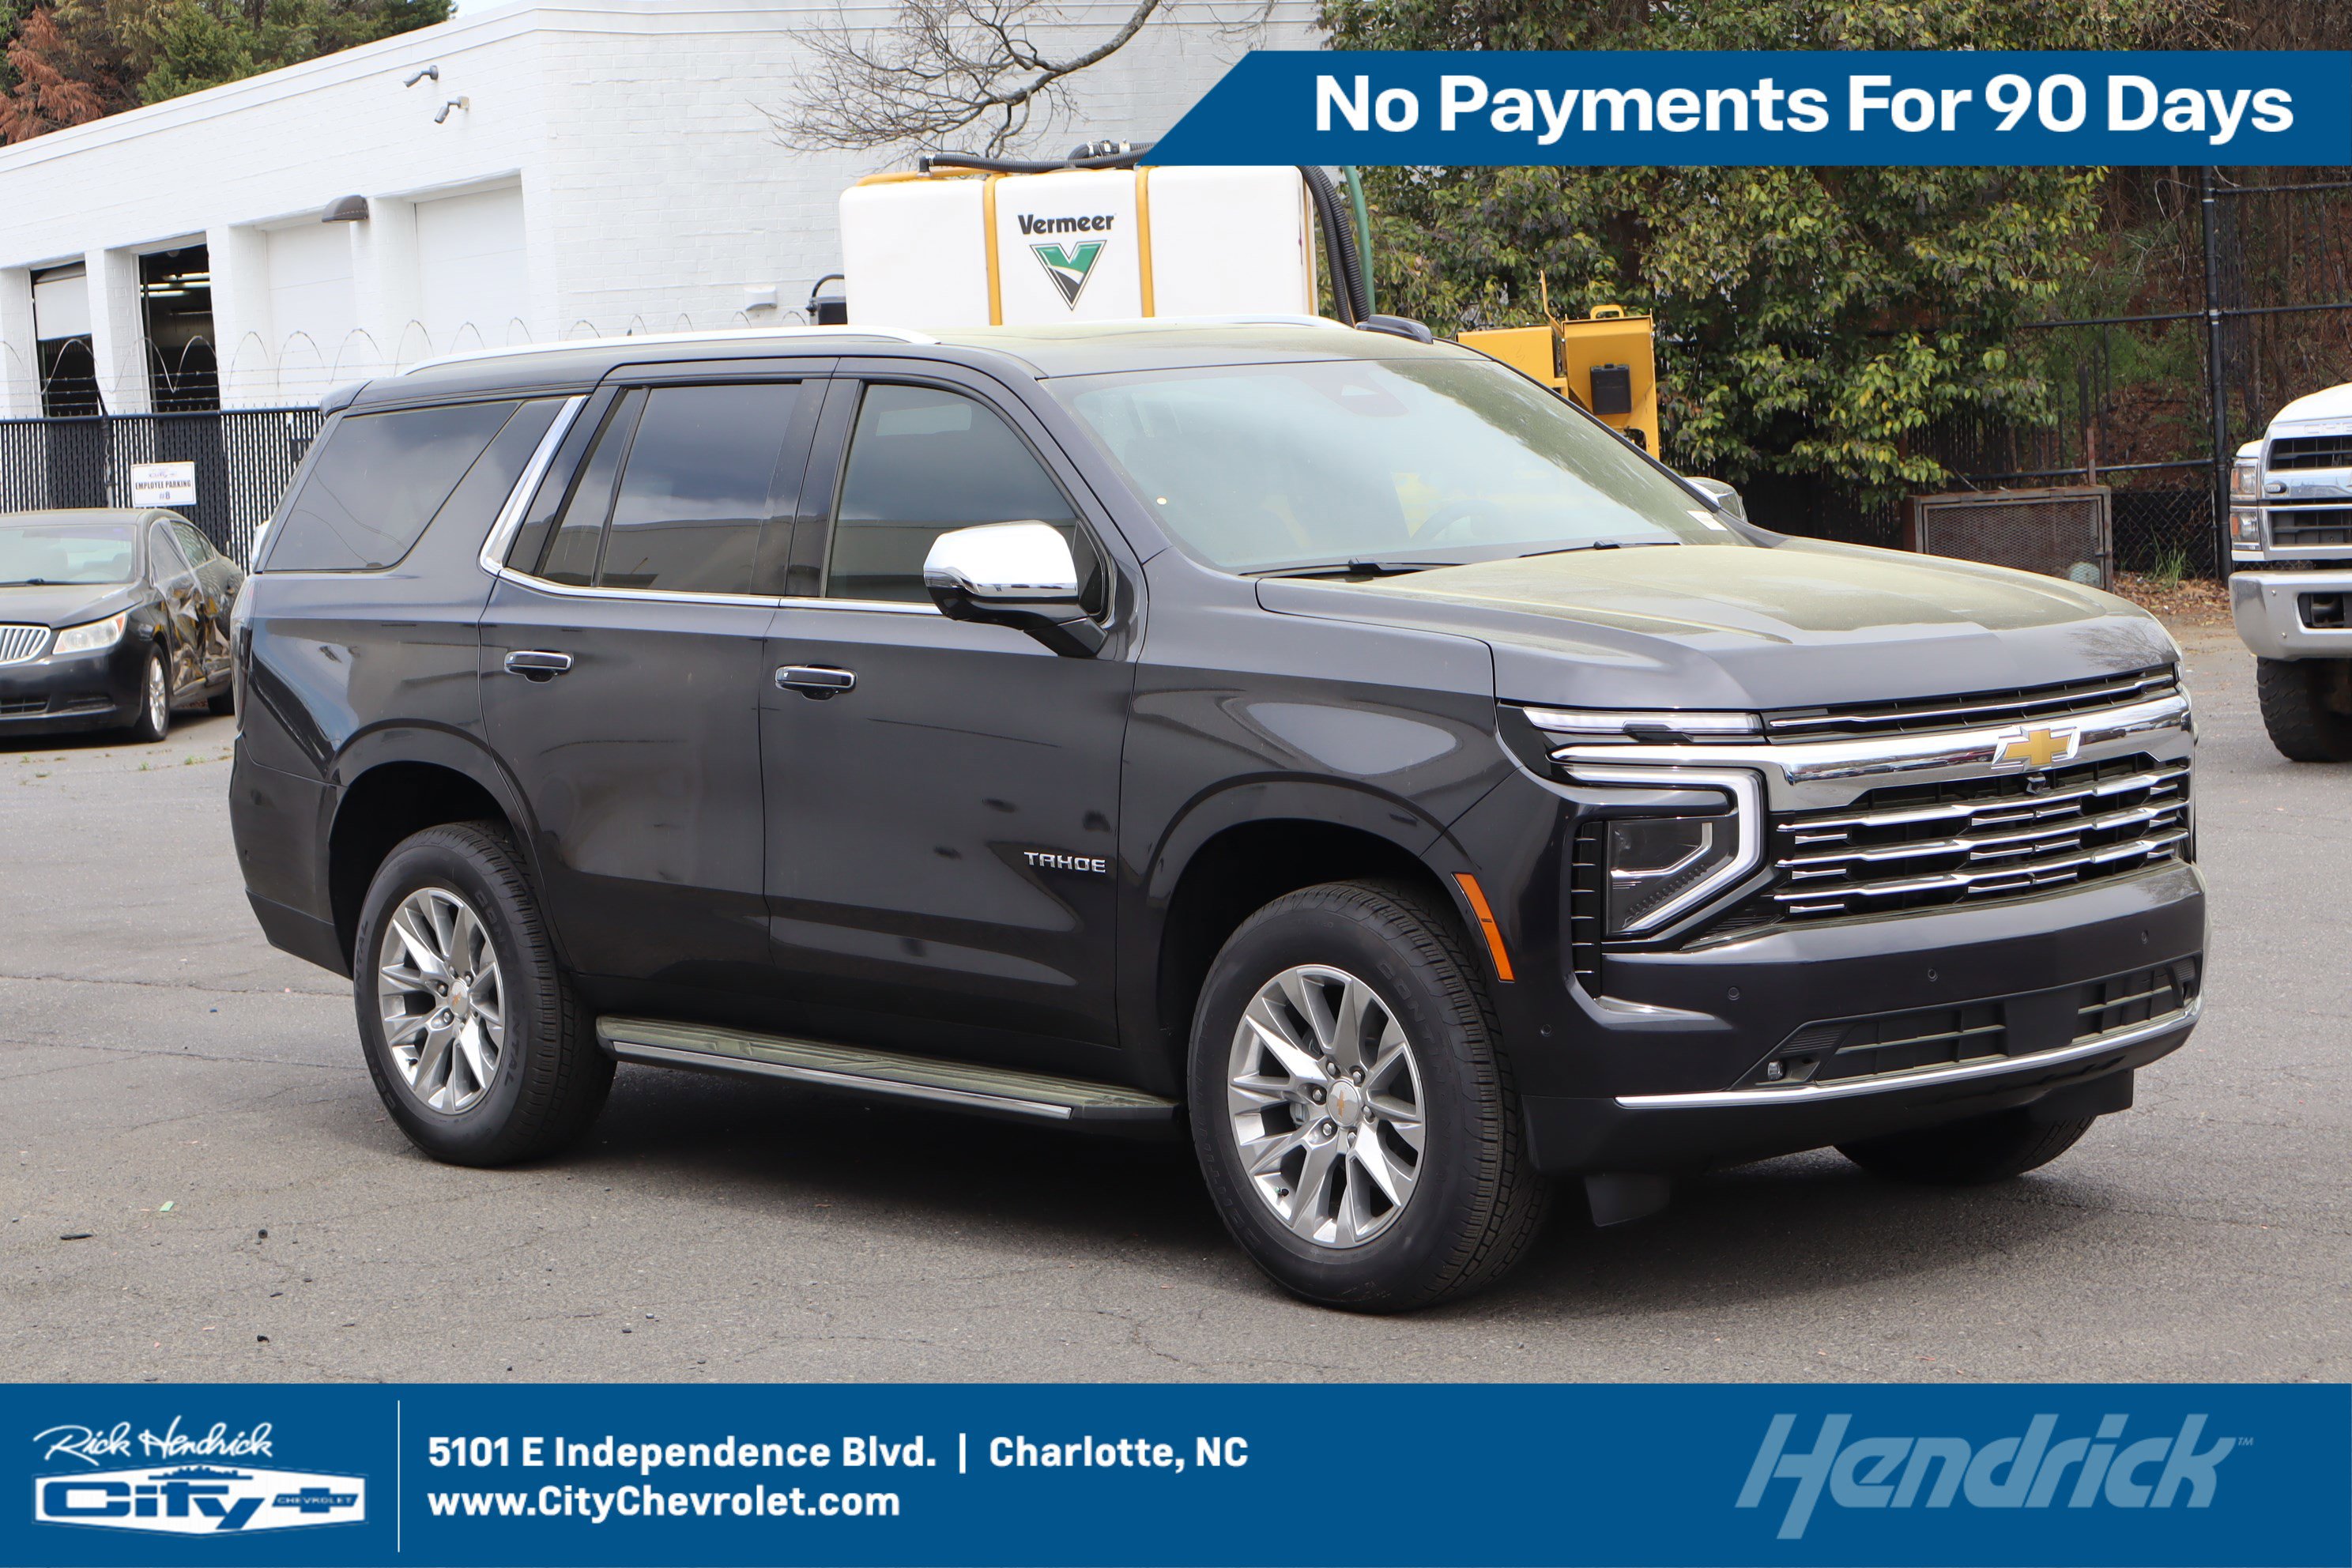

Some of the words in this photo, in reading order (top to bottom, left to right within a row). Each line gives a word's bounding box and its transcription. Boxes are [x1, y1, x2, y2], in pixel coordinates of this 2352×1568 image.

[1018, 214, 1114, 235] Vermeer
[135, 481, 164, 490] EMPLOYEE
[165, 480, 191, 488] PARKING
[1023, 851, 1106, 873] TAHOE
